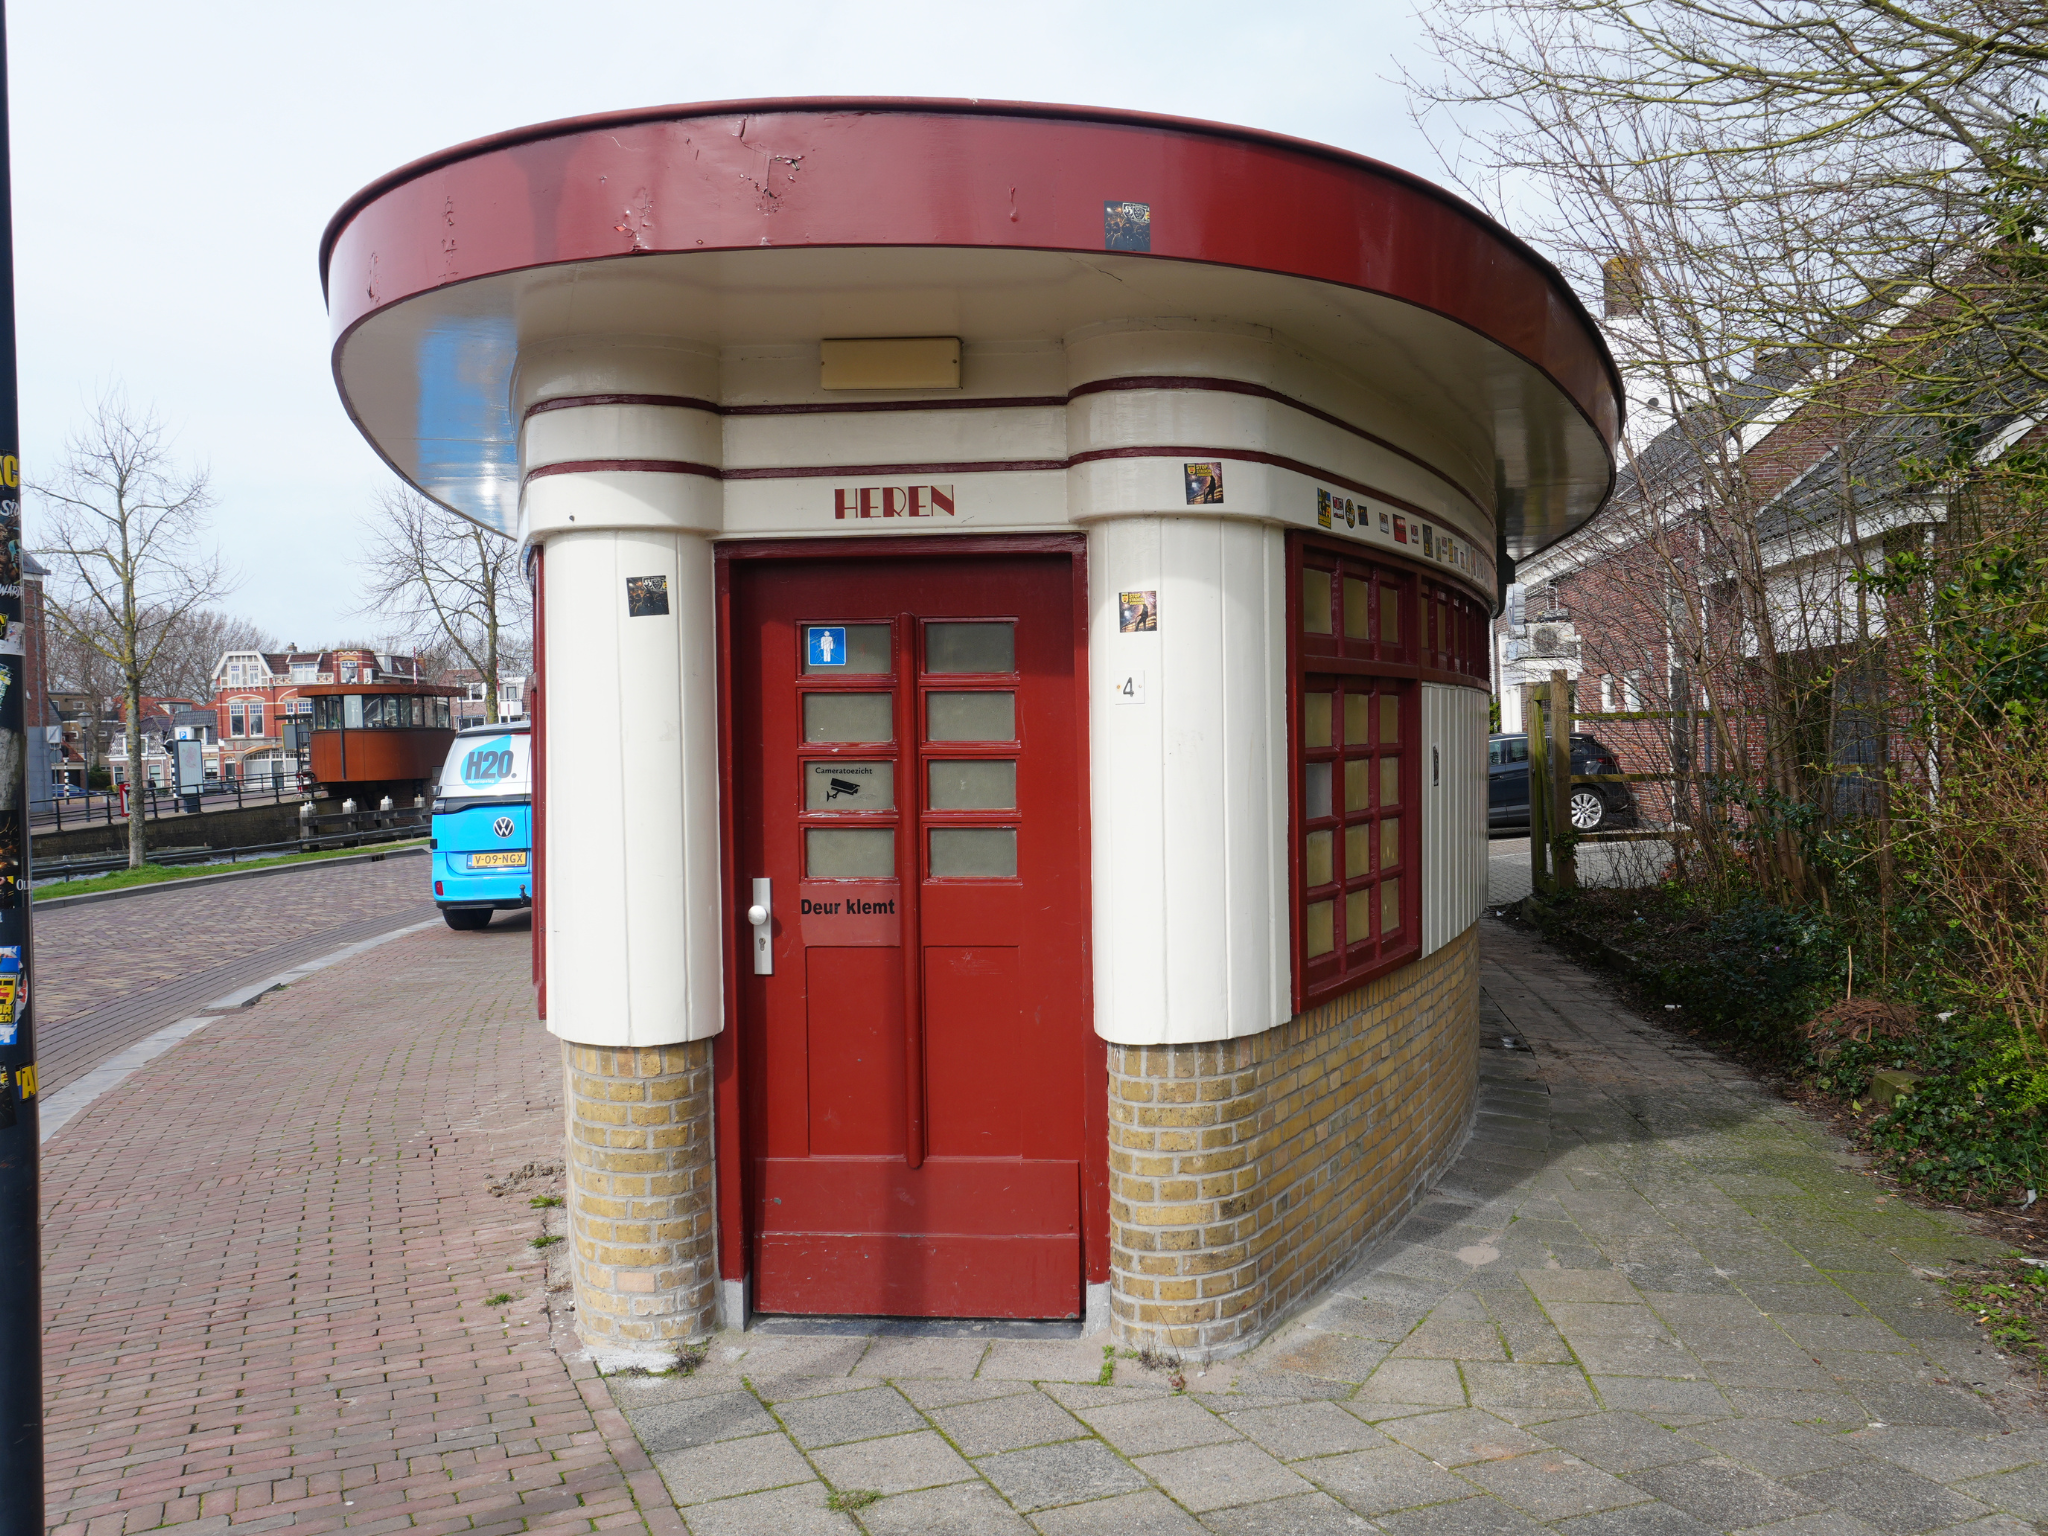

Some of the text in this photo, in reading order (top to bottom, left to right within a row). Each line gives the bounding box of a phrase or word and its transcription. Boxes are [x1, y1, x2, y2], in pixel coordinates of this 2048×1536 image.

[835, 485, 955, 519] HEREN
[1122, 676, 1135, 698] 4
[815, 767, 873, 775] Cameratoezicht
[474, 853, 524, 865] V-09-NGX
[801, 898, 895, 915] Deur klemt
